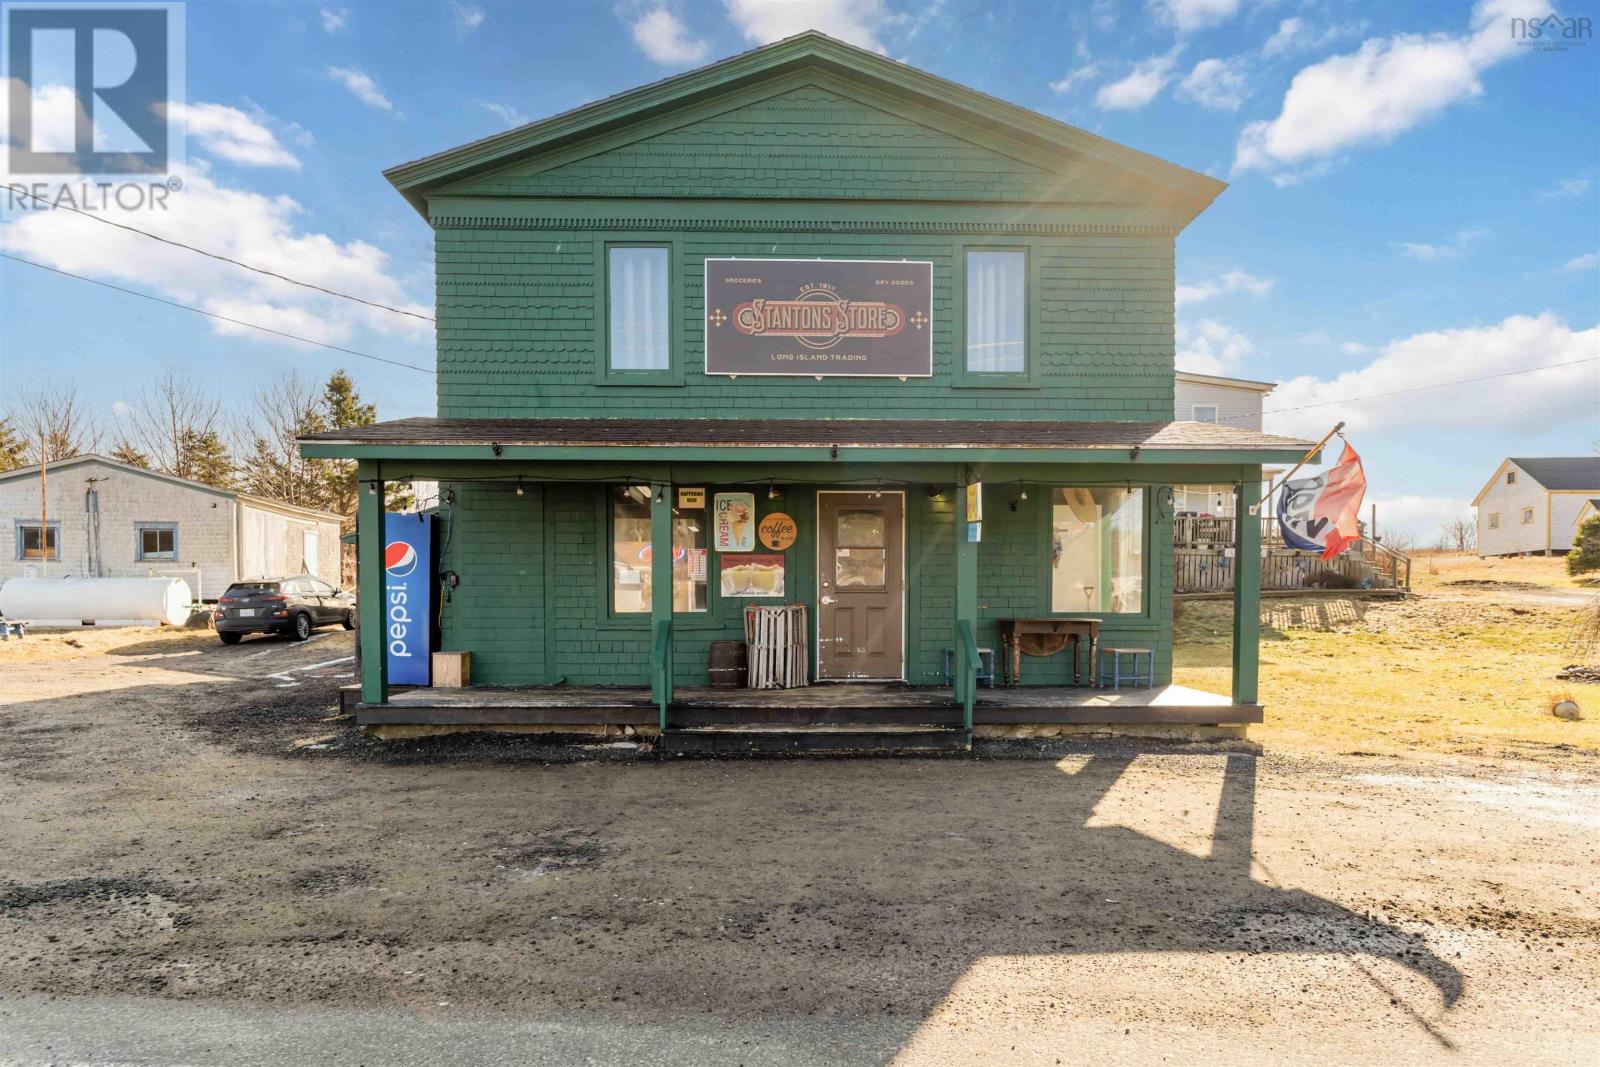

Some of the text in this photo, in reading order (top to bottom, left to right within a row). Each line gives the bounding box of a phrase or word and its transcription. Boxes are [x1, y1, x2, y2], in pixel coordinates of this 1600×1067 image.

[751, 299, 888, 335] STANTONS STORE
[771, 353, 794, 361] LONG
[796, 353, 828, 361] ISLAND
[715, 499, 733, 512] ICE
[718, 511, 730, 547] CREAM
[761, 521, 793, 538] coffee
